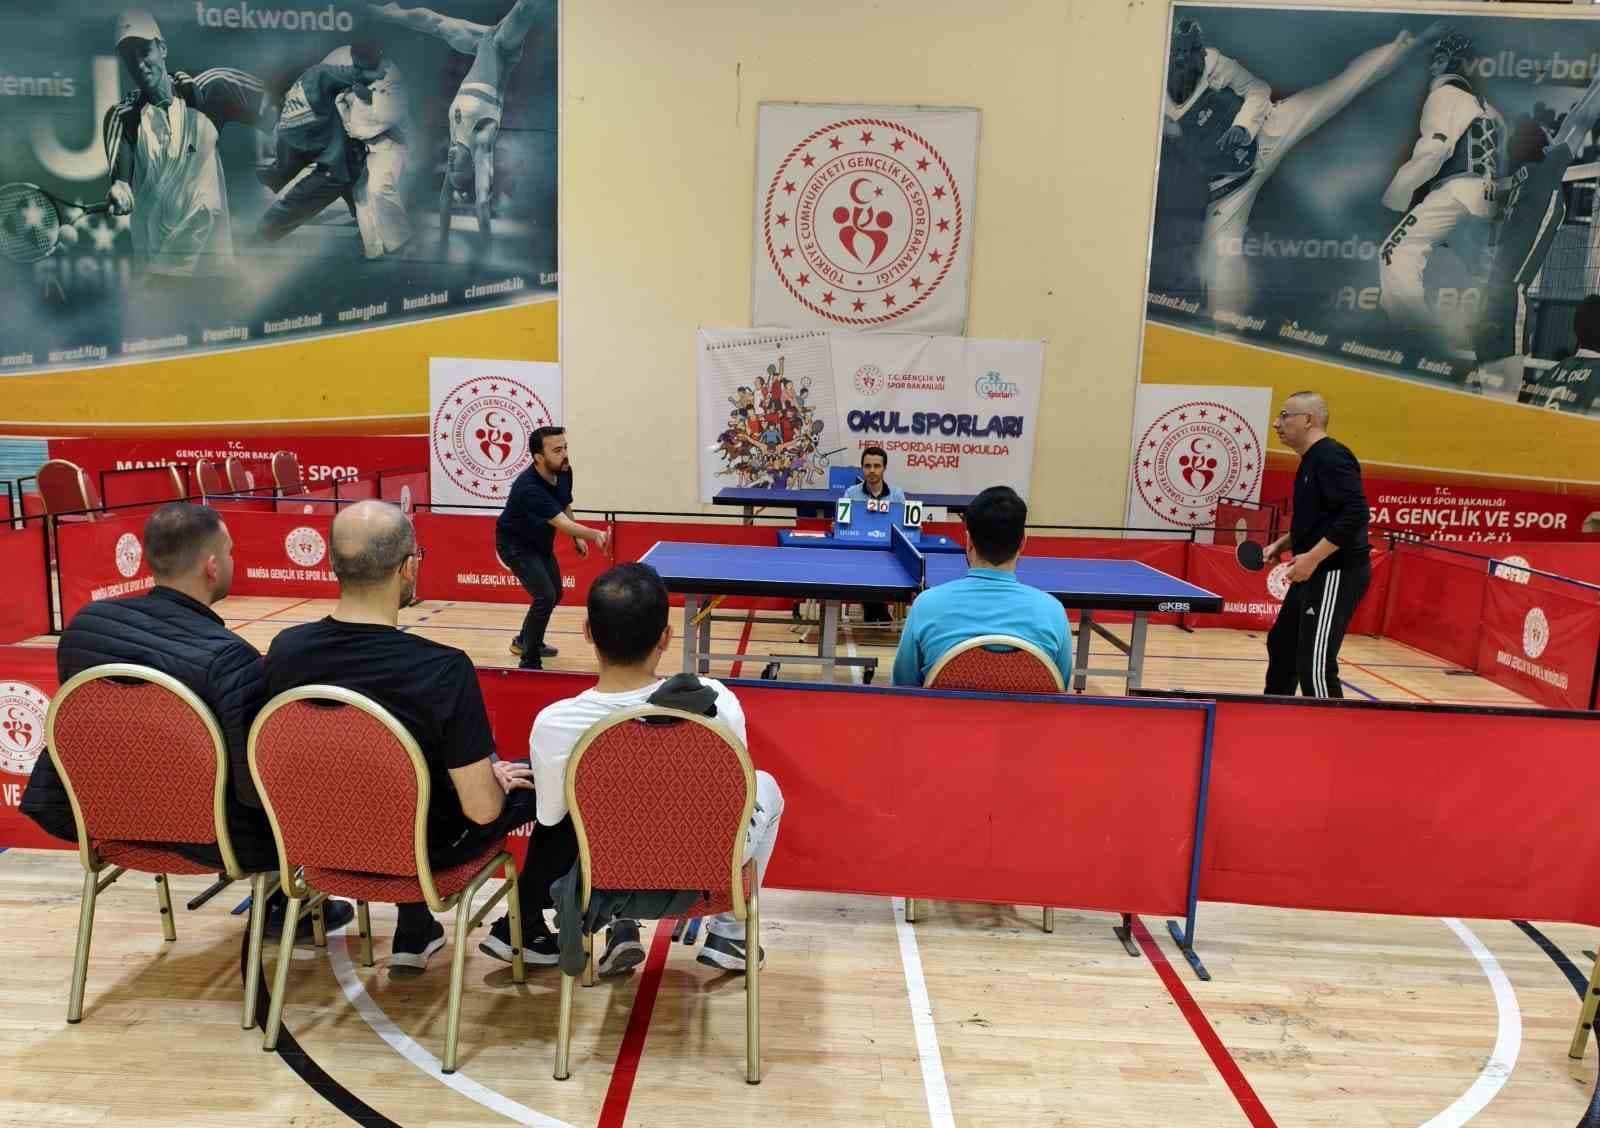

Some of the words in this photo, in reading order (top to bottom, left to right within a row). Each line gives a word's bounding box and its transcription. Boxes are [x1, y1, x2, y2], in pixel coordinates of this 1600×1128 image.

[196, 2, 353, 32] taekwondo
[847, 156, 902, 177] GENÇLİK
[900, 174, 916, 191] VE
[801, 160, 846, 239] CUMHURİYETİ
[910, 191, 926, 226] SPOR
[804, 242, 846, 284] TÜRKİYE
[876, 229, 926, 284] BAKANLIĞI
[847, 409, 910, 433] OKUL
[911, 411, 1024, 438] SPORLARI
[176, 449, 214, 459] GENÇLİK
[215, 450, 227, 458] VE
[228, 441, 244, 449] T.C.
[858, 440, 884, 450] HEM
[886, 440, 934, 452] SPORDA
[934, 442, 961, 454] HEM
[962, 444, 1009, 456] OKULDA
[308, 464, 359, 482] SPOR
[907, 455, 960, 470] BAŞARI
[1378, 495, 1418, 505] GENÇLİK
[1420, 495, 1432, 505] VE
[1433, 495, 1456, 505] SPOR
[1458, 496, 1506, 507] BAKANLIĞI
[1435, 487, 1451, 495] T.C.
[839, 502, 850, 521] 7
[905, 503, 921, 525] 10
[1395, 506, 1481, 530] GENÇLİK
[1484, 510, 1509, 528] VE
[1513, 511, 1568, 529] SPOR
